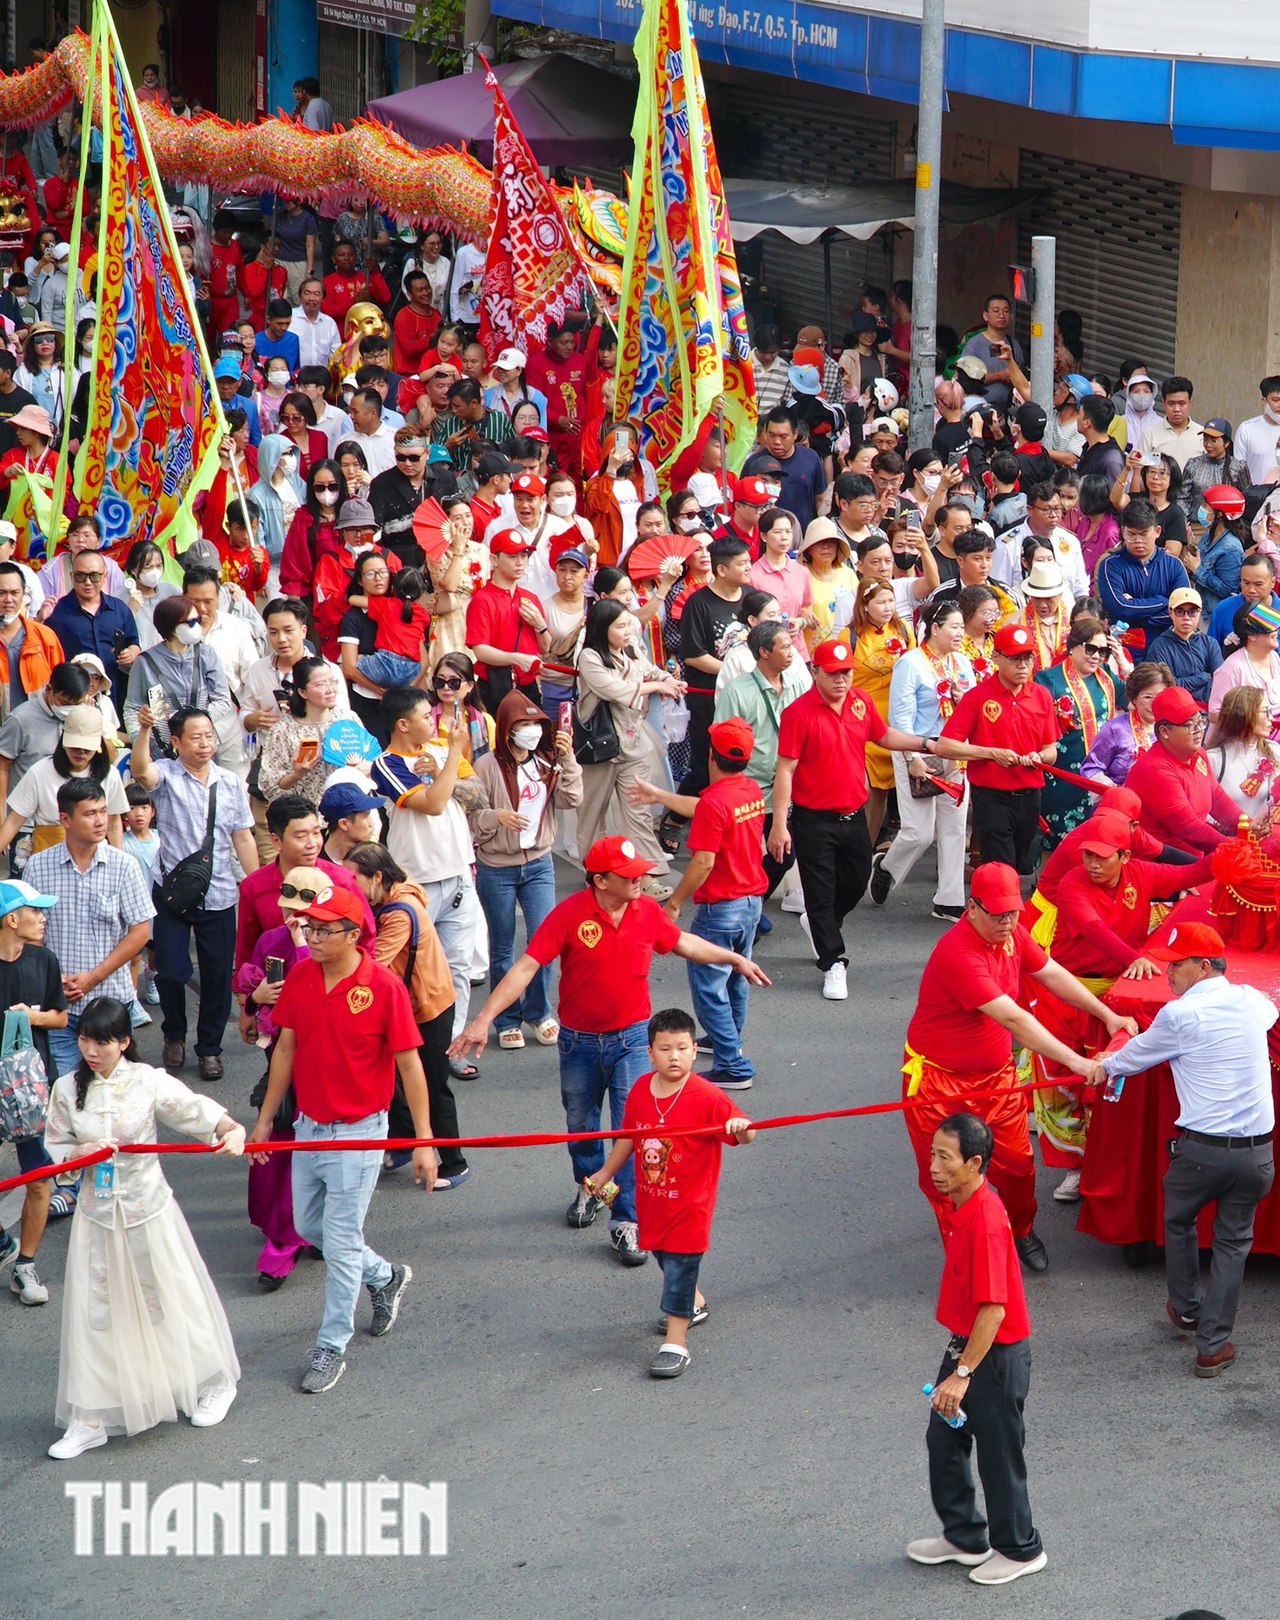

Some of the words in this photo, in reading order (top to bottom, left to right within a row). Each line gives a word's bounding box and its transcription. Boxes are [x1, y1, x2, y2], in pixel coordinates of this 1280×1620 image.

[718, 6, 741, 33] Đạo,
[743, 10, 762, 38] F.7,
[765, 15, 787, 39] Q.5.
[791, 19, 808, 45] Tp.
[810, 23, 837, 48] HCM
